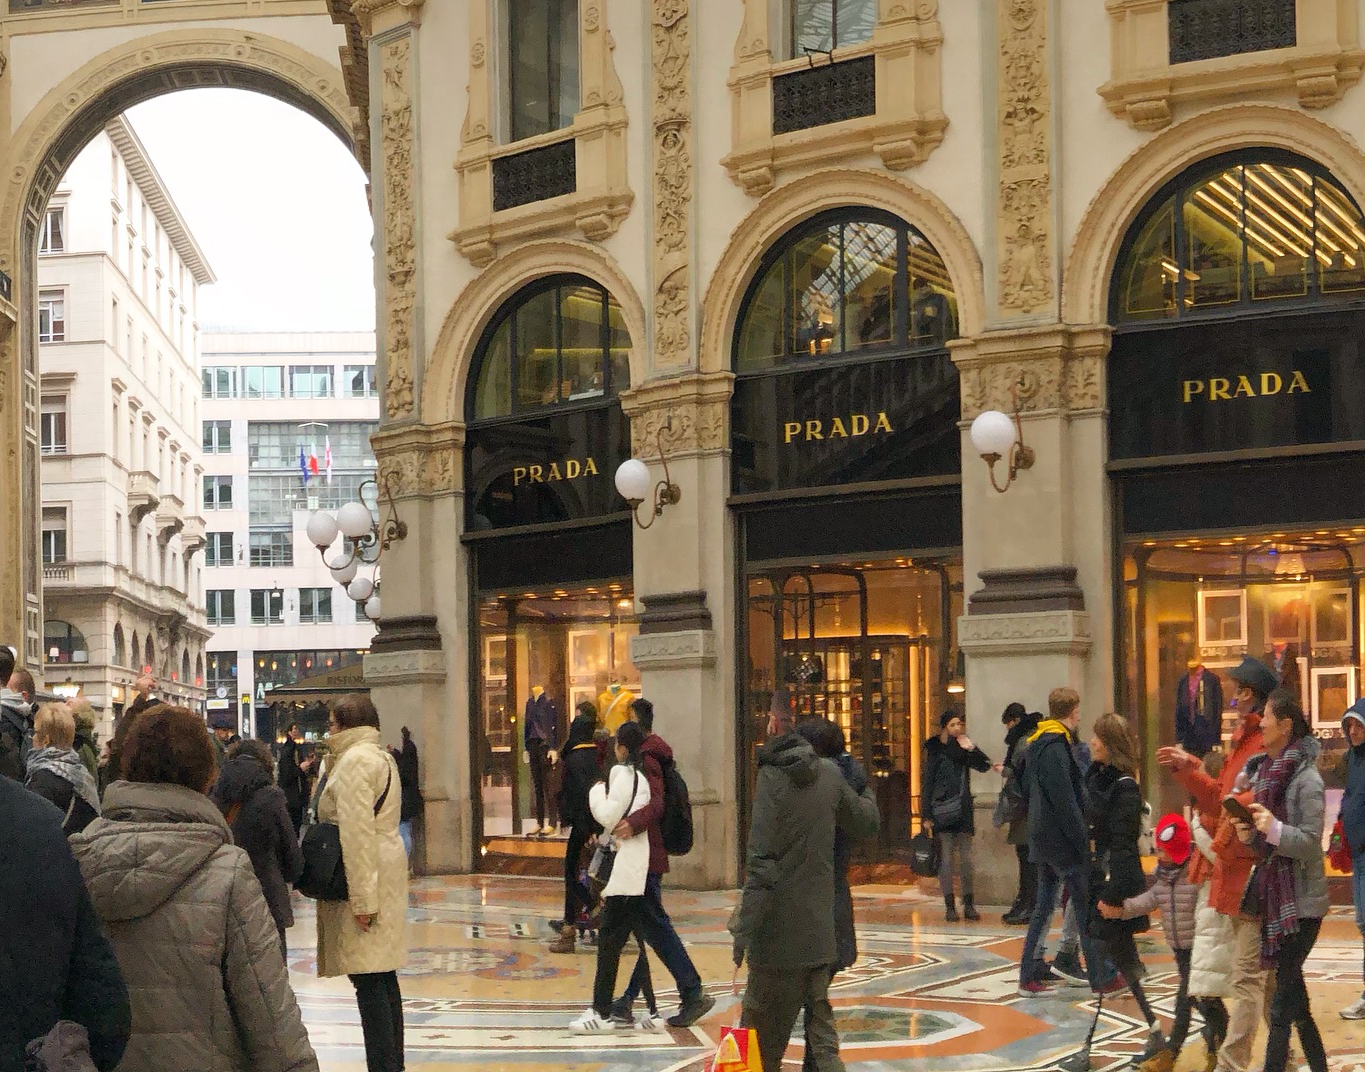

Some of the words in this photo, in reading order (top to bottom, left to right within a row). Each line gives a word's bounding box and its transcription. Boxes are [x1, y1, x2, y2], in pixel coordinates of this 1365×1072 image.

[1178, 370, 1311, 403] PRADA
[784, 412, 895, 444] PRADA
[512, 457, 600, 487] PRADA
